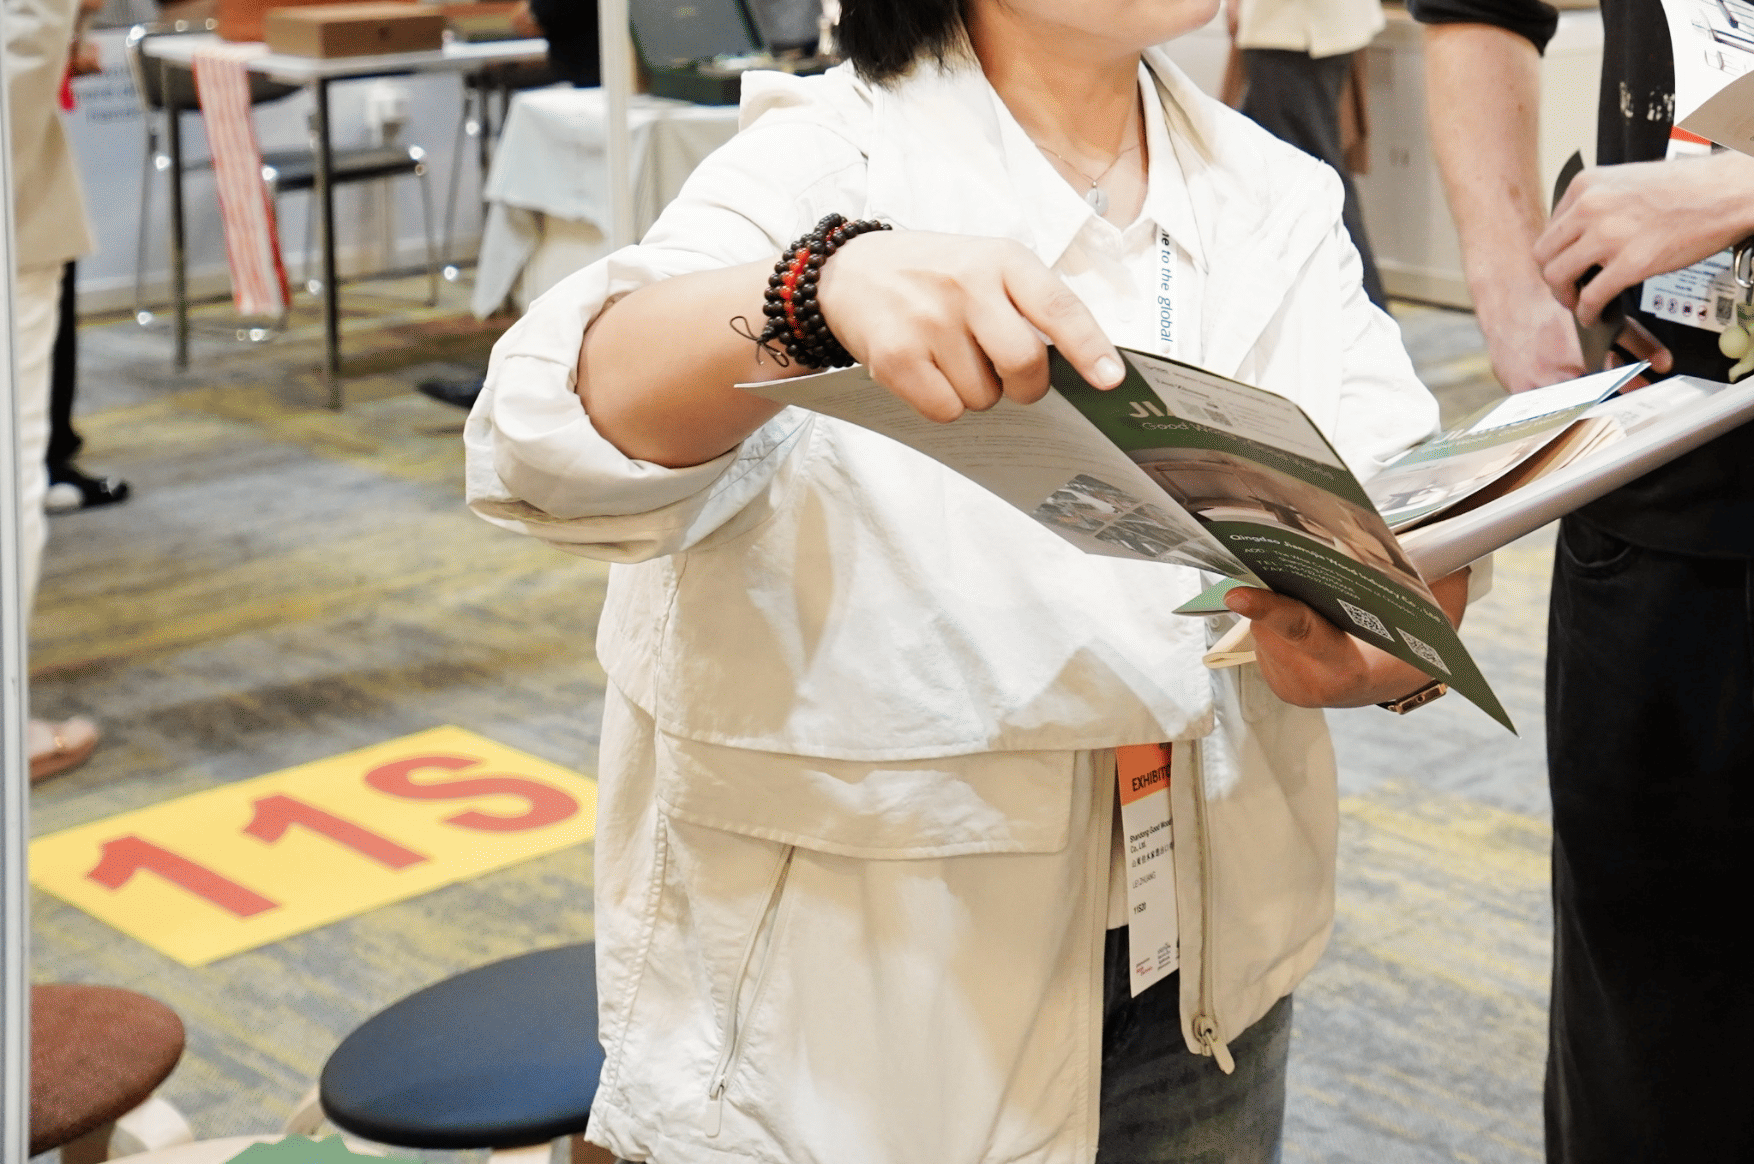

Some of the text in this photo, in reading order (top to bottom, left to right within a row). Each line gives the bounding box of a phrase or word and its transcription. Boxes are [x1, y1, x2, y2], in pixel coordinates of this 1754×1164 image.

[1161, 249, 1171, 264] to
[1161, 267, 1172, 291] the
[1157, 295, 1174, 343] global
[1229, 534, 1281, 545] Qingdao
[1131, 763, 1172, 792] EXHIBITO
[85, 753, 582, 919] 11S
